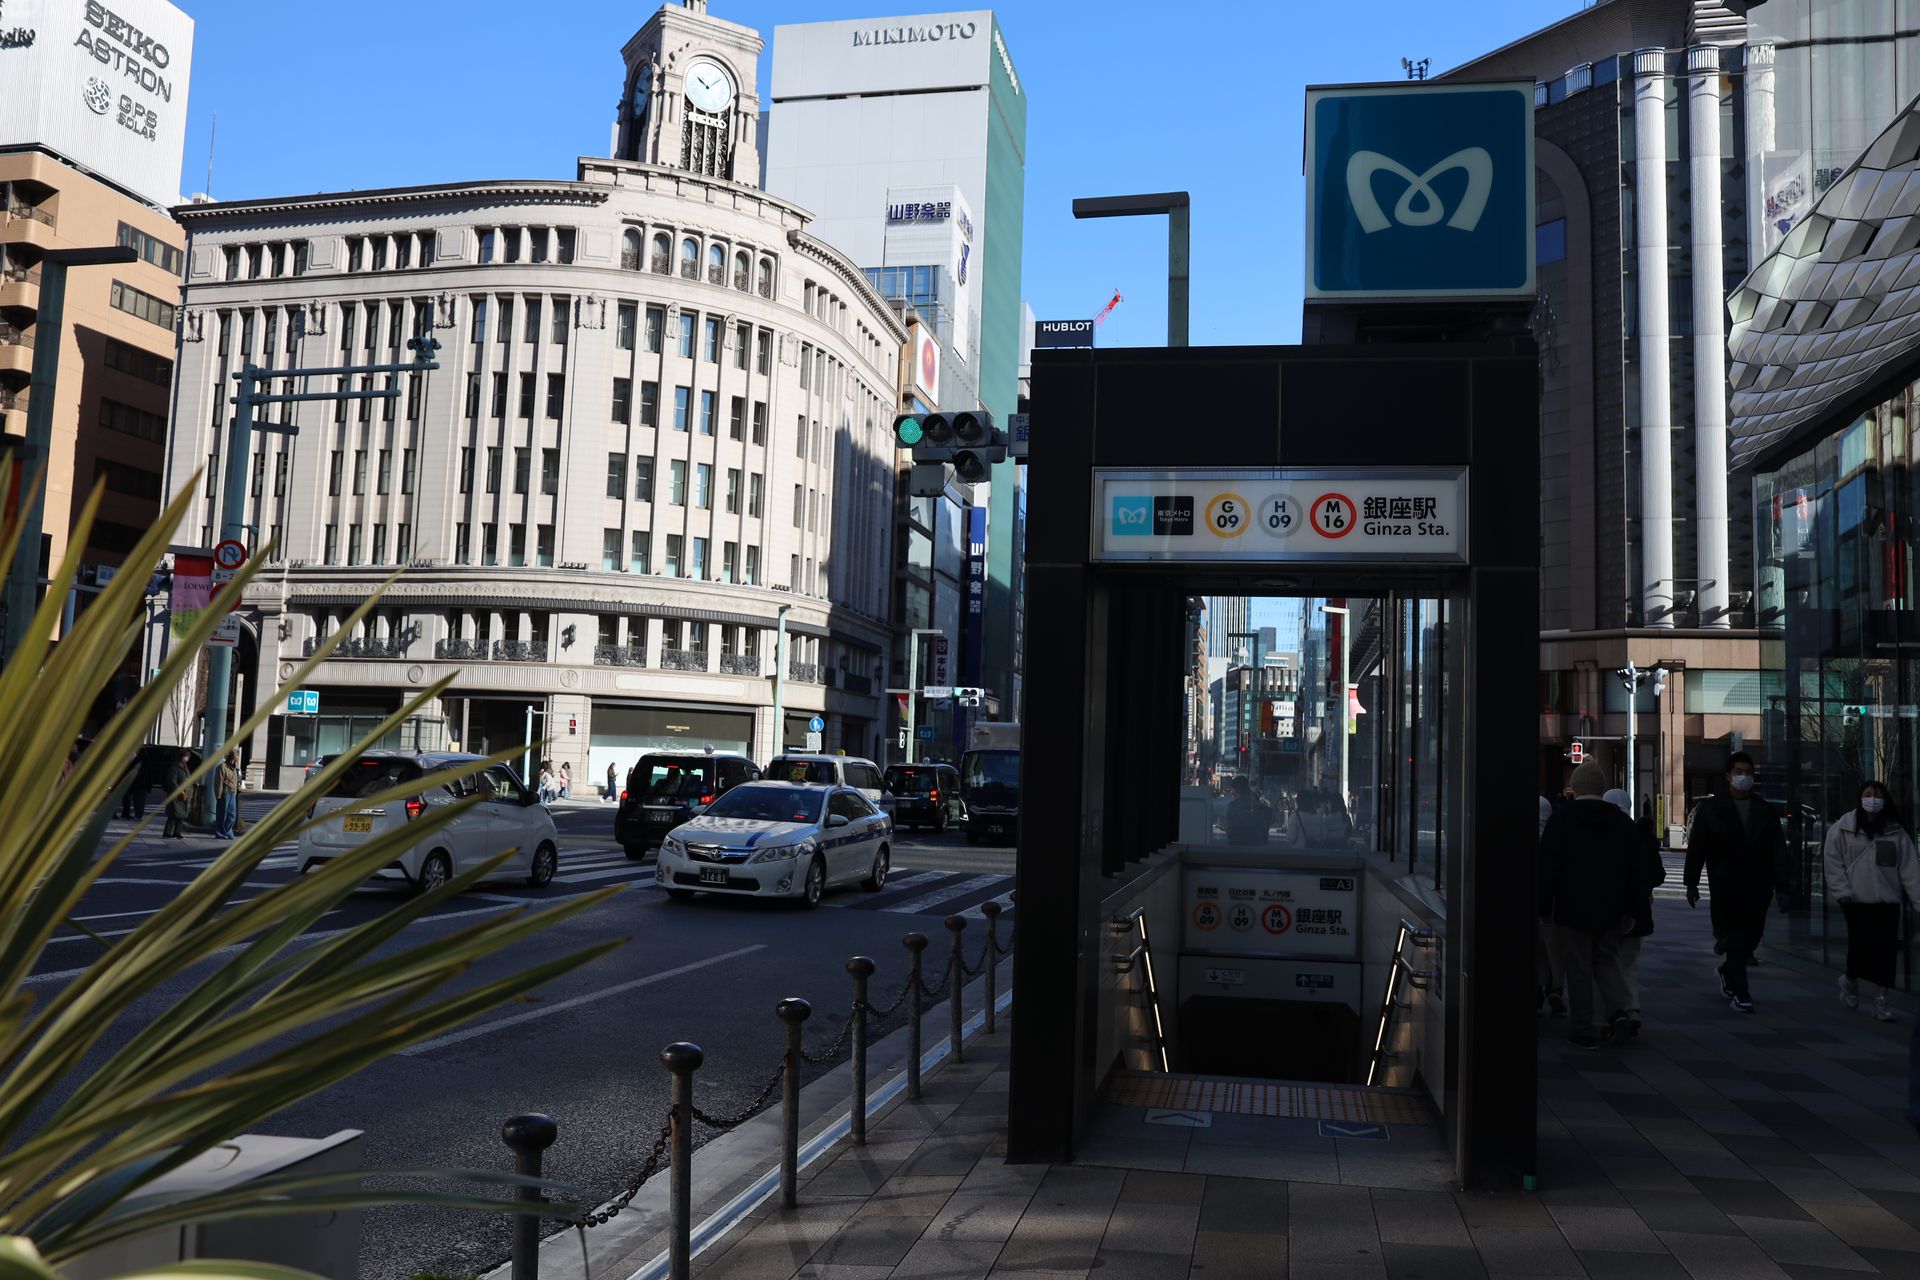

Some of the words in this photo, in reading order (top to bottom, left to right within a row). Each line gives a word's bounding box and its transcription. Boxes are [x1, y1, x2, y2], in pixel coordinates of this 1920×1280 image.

[84, 0, 171, 69] SEIKO
[853, 22, 978, 47] MIKIMOTO
[73, 28, 172, 103] ASTRON
[118, 94, 158, 129] GPS
[116, 112, 157, 142] SOLAR
[890, 202, 951, 220] 山野楽器
[1043, 322, 1092, 332] HUBLOT
[1222, 501, 1234, 513] G
[1274, 501, 1286, 513] H
[1325, 501, 1341, 513] M
[1363, 497, 1437, 519] 銀座駅
[1216, 514, 1239, 529] 09
[1269, 514, 1292, 528] 09
[1324, 515, 1345, 529] 16
[1364, 522, 1412, 536] Ginza
[1418, 522, 1450, 536] Sta.
[184, 583, 211, 592] LOEWE
[1337, 879, 1353, 890] A3
[1203, 907, 1211, 915] G
[1238, 908, 1246, 916] H
[1295, 908, 1342, 924] 銀座駅
[1199, 916, 1215, 925] 09
[1234, 917, 1249, 926] 09
[1270, 919, 1283, 928] 16
[1296, 924, 1326, 935] Ginza
[1329, 926, 1350, 936] Sta.
